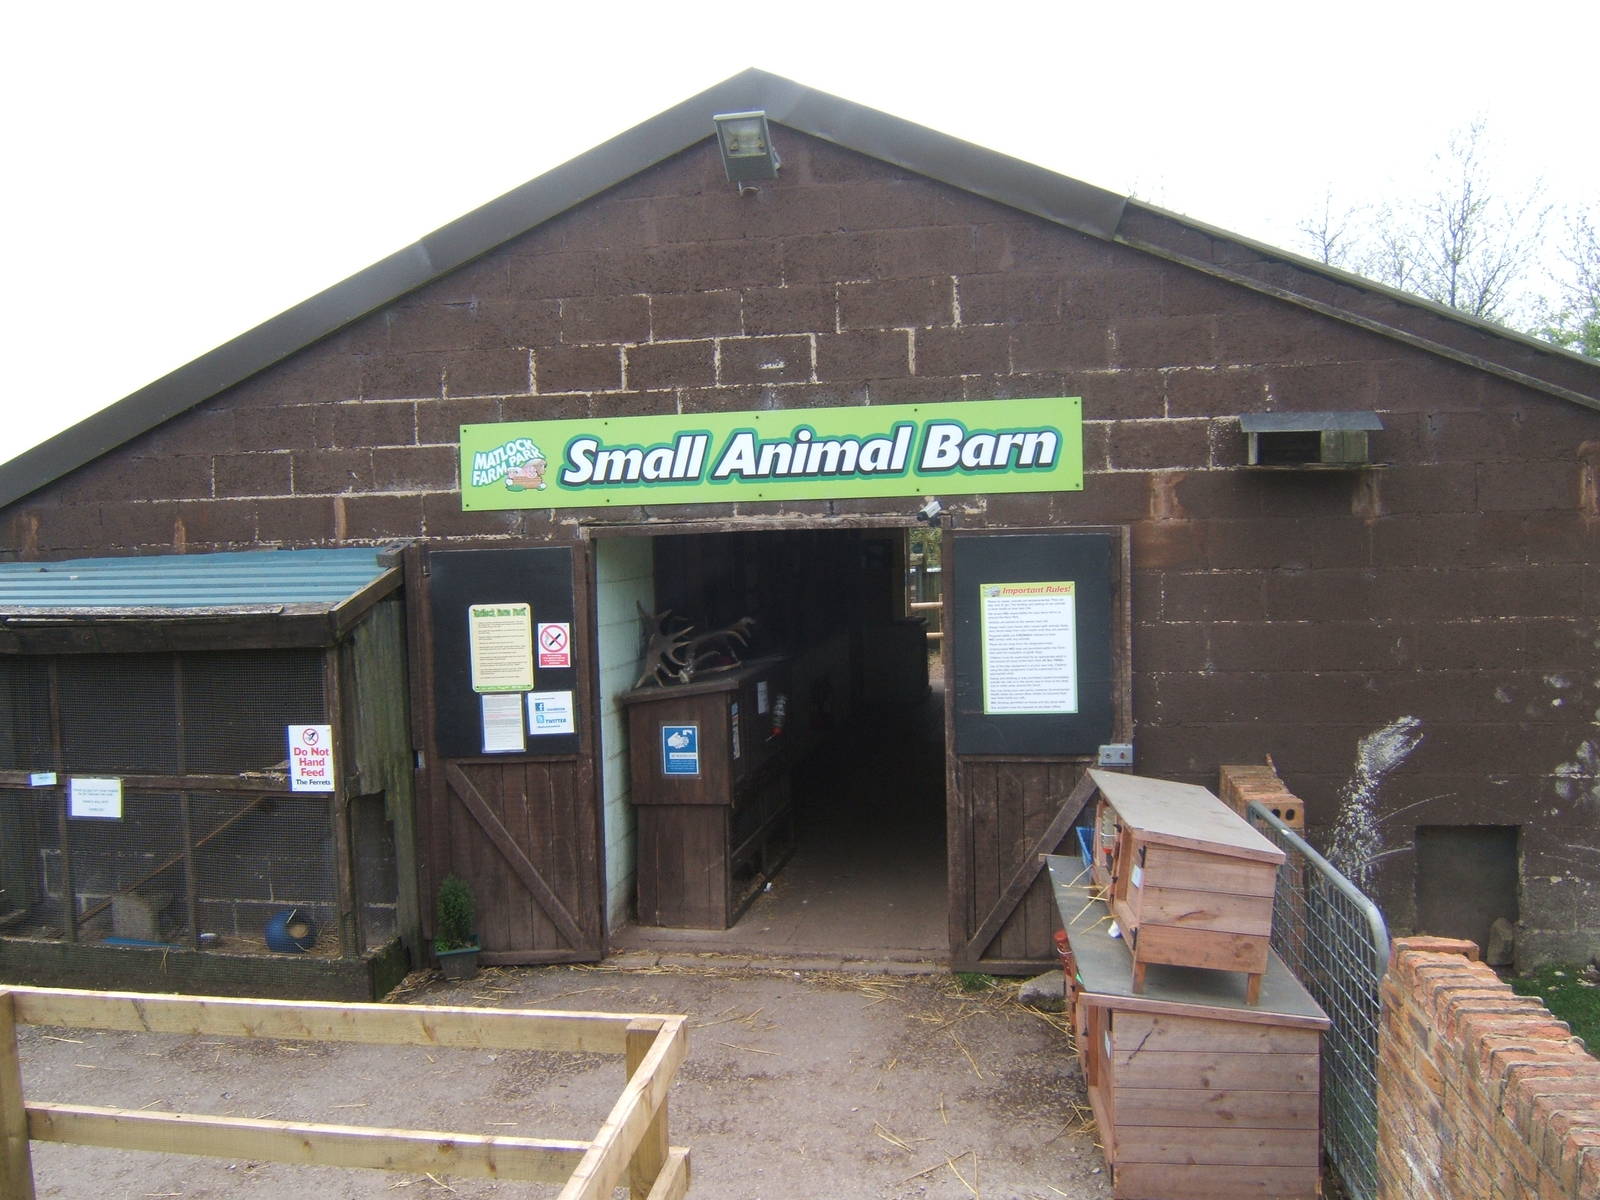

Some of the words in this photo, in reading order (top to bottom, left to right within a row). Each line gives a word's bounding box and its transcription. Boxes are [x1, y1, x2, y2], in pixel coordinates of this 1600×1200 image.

[474, 439, 538, 470] MATLOCK
[562, 433, 709, 484] Small
[711, 426, 914, 478] Animal
[920, 424, 1058, 469] Barn
[473, 461, 507, 486] FARM
[509, 450, 544, 466] PARK
[1002, 586, 1044, 594] Important
[1046, 585, 1071, 593] Rules!
[293, 747, 308, 756] Do
[311, 747, 329, 756] Not
[299, 757, 325, 767] Hand
[300, 768, 325, 777] Feed
